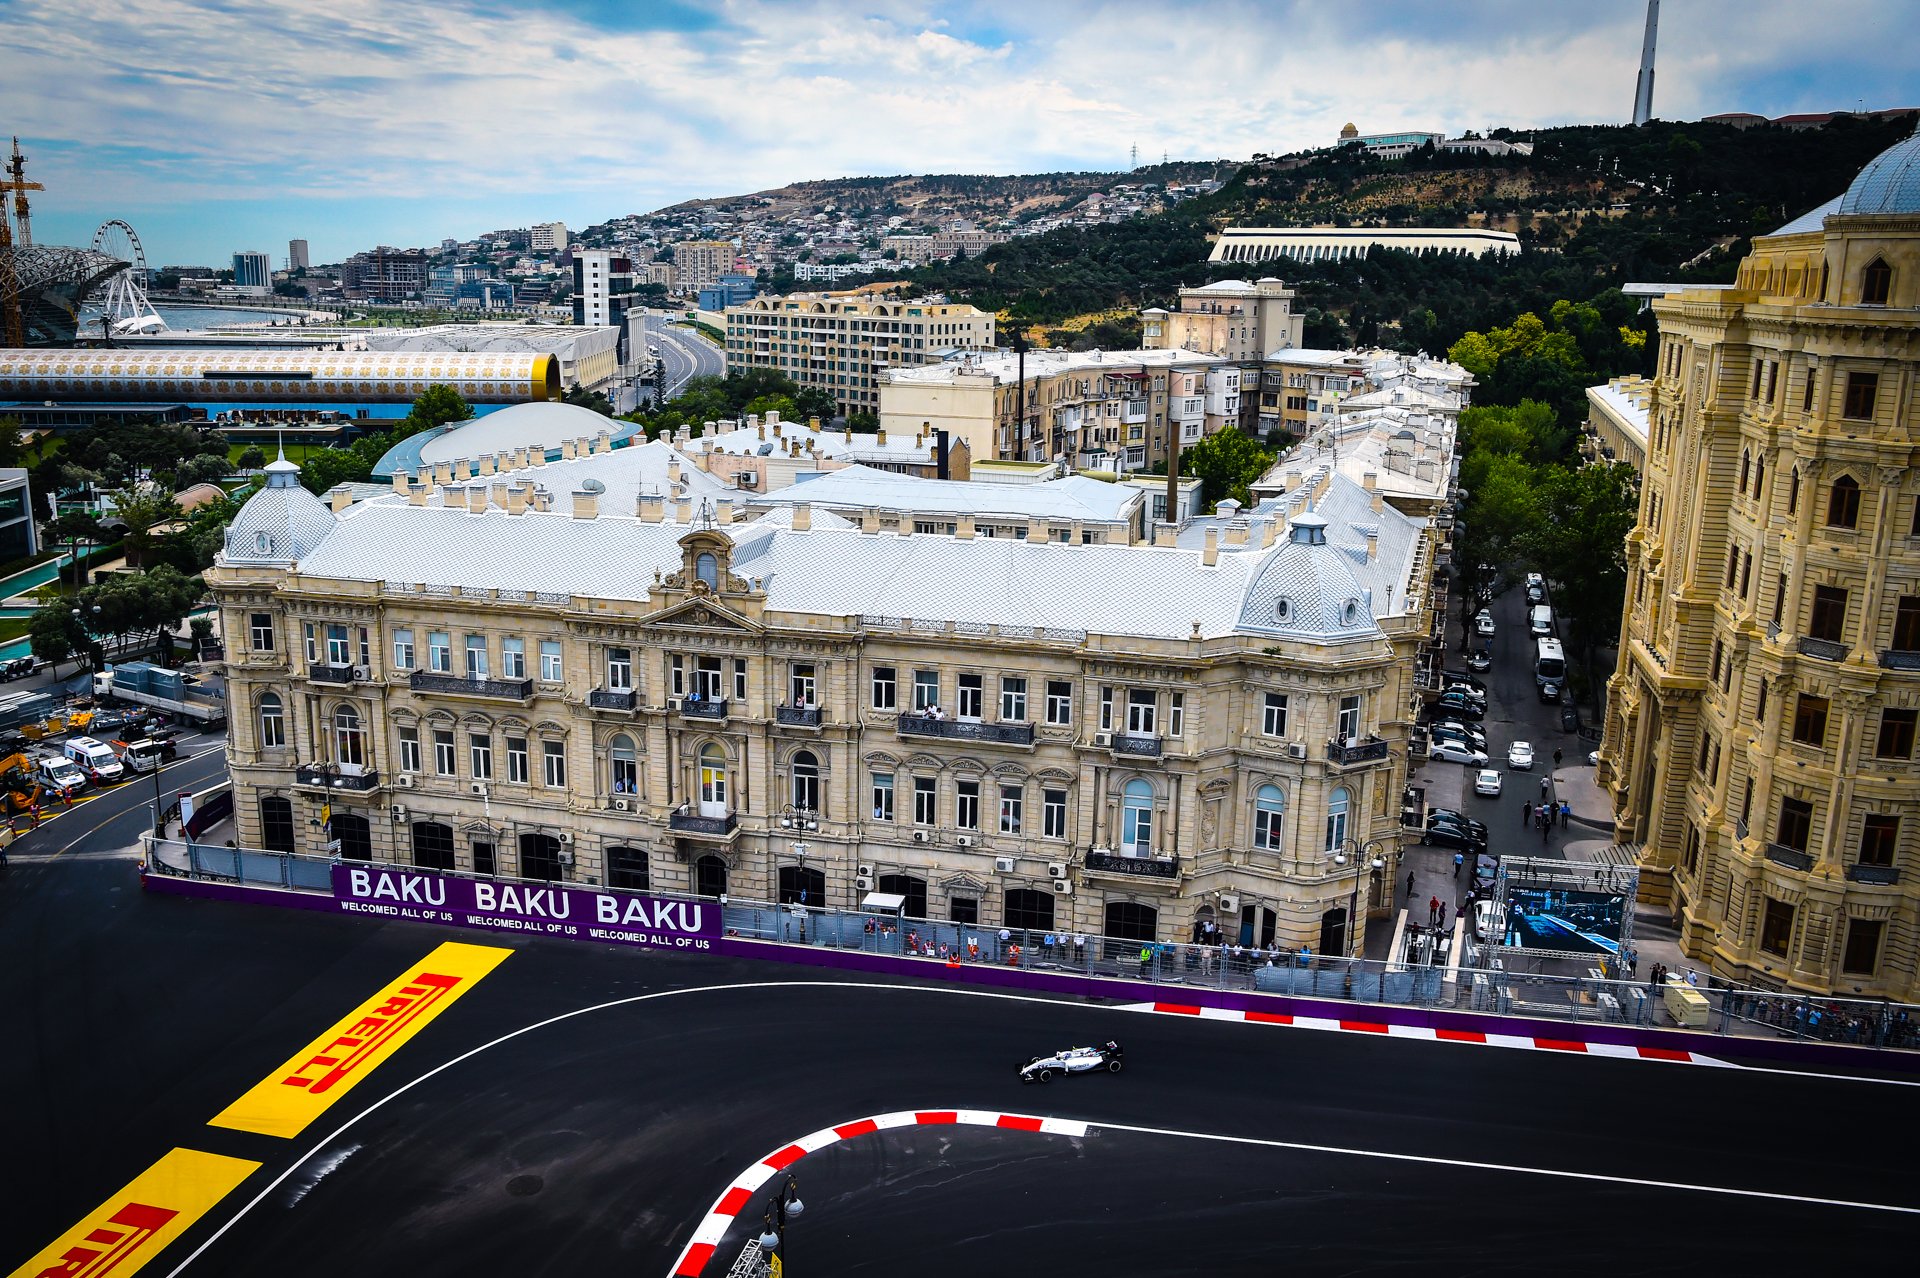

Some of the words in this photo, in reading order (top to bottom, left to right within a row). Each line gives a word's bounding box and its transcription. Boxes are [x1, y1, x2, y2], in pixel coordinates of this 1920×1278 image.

[350, 869, 446, 906] BAKU
[475, 882, 570, 919] BAKU
[341, 901, 398, 916] WELCOMED
[401, 907, 420, 918] ALL
[422, 910, 436, 920] OF
[441, 912, 453, 921] US
[467, 915, 522, 929] WELCOMED
[524, 921, 543, 932] ALL
[547, 923, 562, 933] OF
[564, 925, 577, 935] US
[596, 894, 702, 932] BAKU
[589, 928, 647, 943] WELCOMED
[650, 934, 672, 946] ALL
[675, 937, 693, 947] OF
[695, 939, 710, 949] US
[280, 972, 464, 1094] PIRELLI
